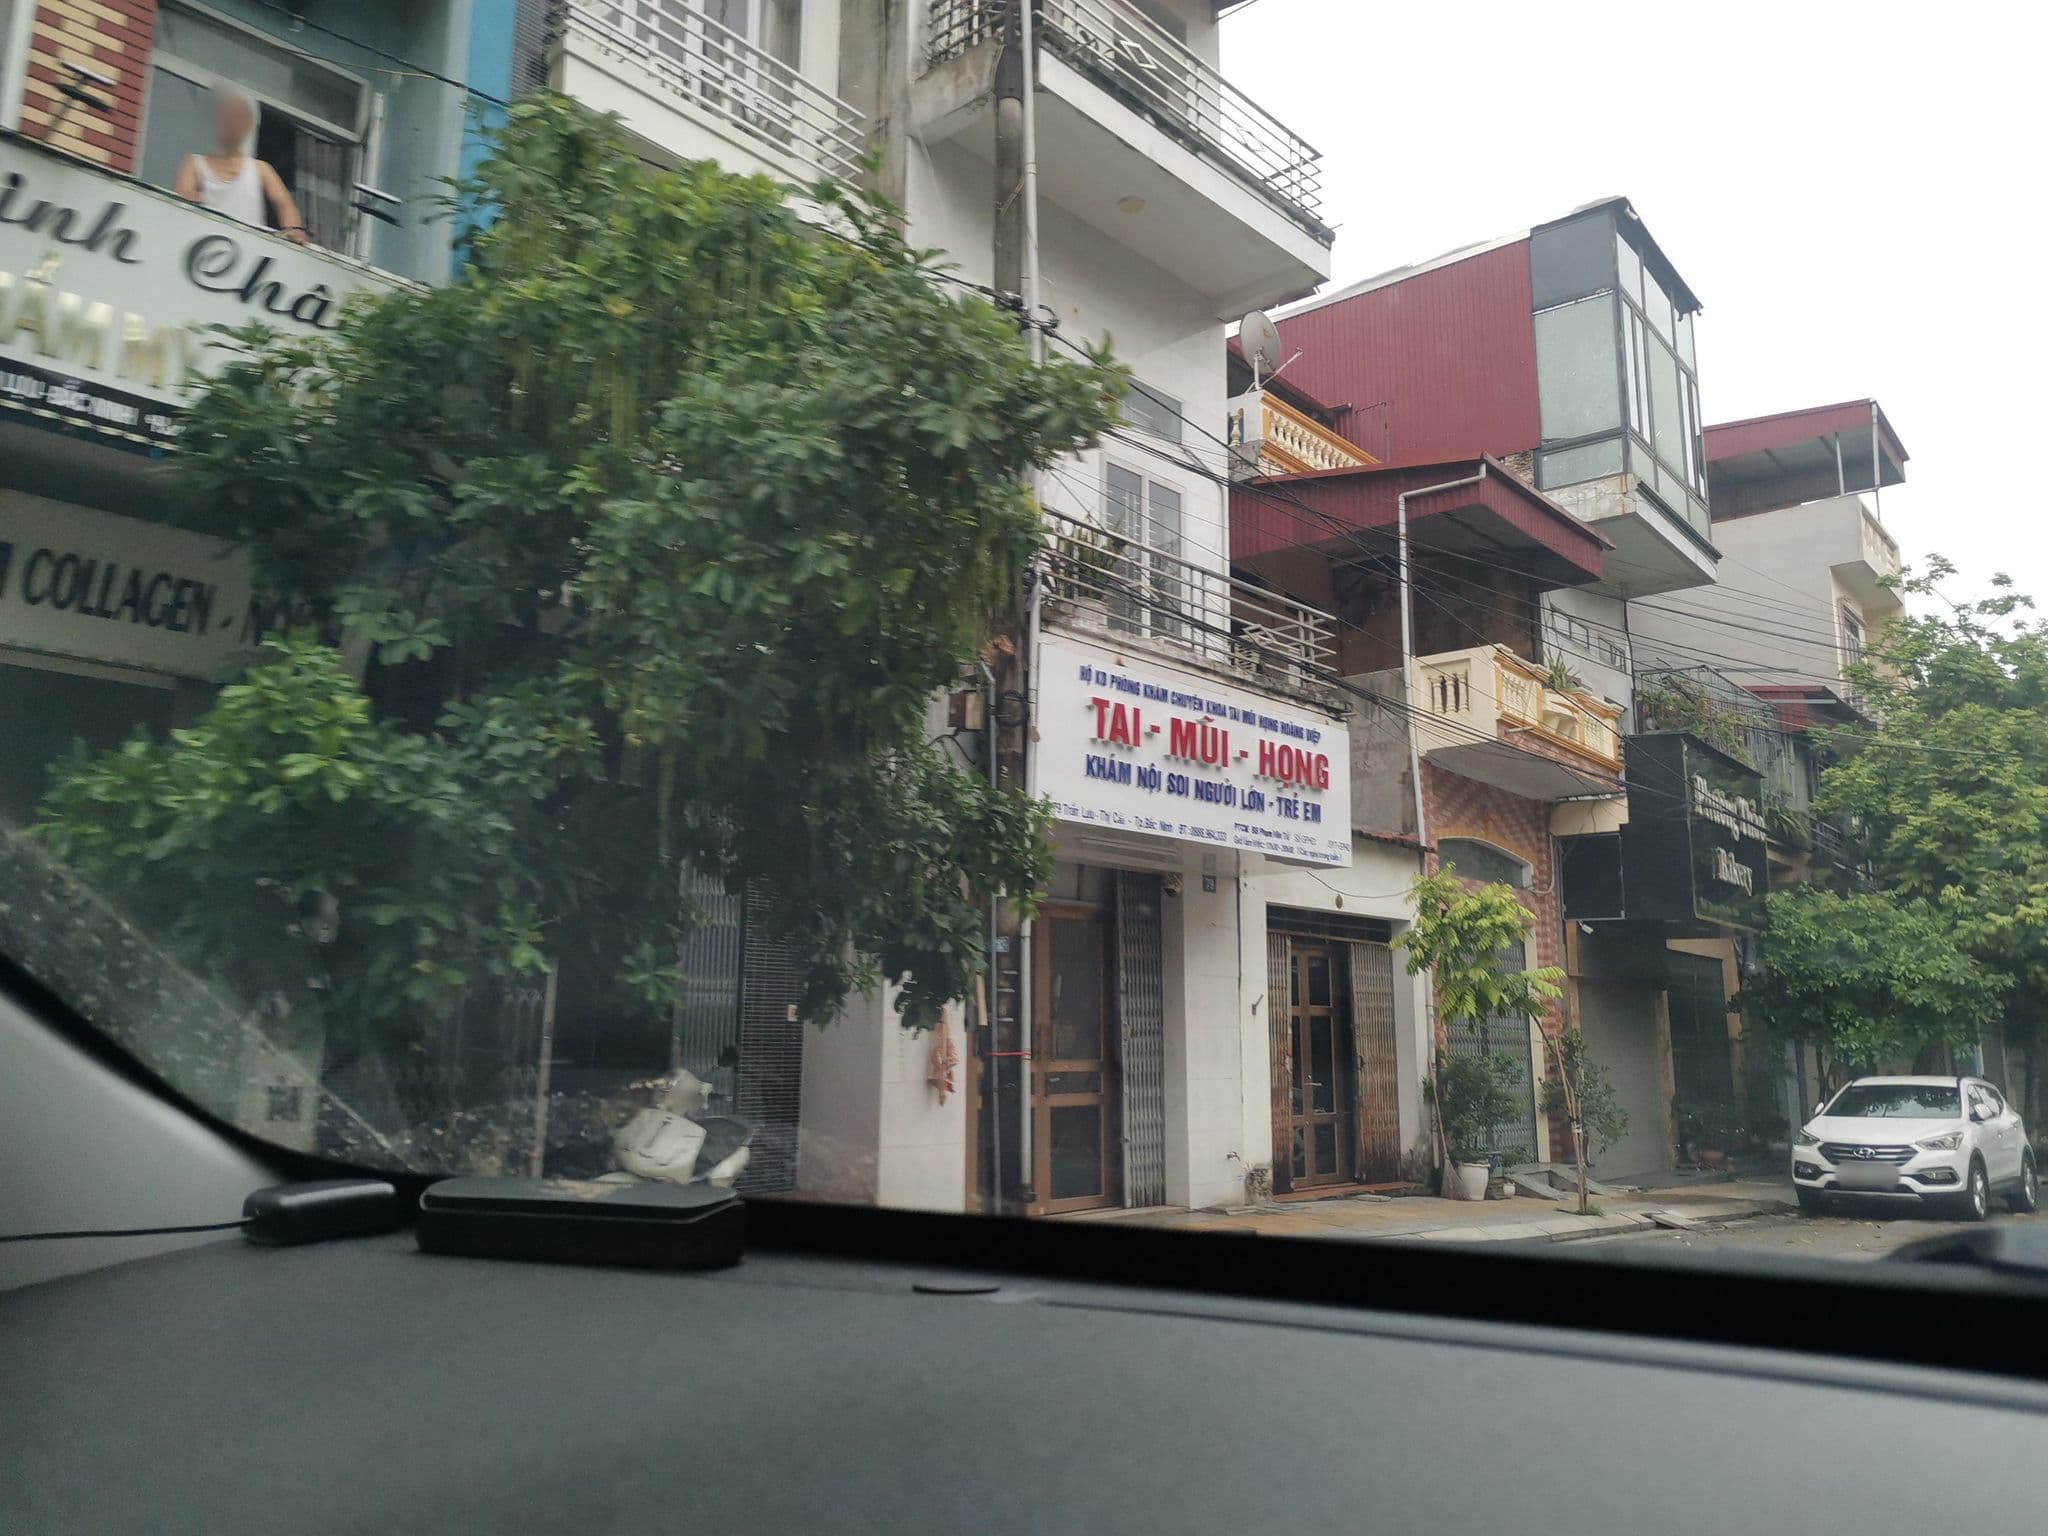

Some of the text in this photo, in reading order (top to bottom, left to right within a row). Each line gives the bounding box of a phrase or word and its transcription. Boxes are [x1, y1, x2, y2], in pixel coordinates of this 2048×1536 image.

[0, 172, 344, 331] inh Châ
[23, 547, 217, 635] COLLAGEN
[1092, 696, 1141, 747] TAI
[1169, 715, 1229, 768] MŨI
[1259, 738, 1330, 790] HỌNG
[1206, 700, 1227, 718] KHOA
[1085, 753, 1131, 786] KHÁM
[1136, 763, 1162, 798] NỘI
[1167, 774, 1190, 797] SOI
[1194, 778, 1237, 808] NGƯỜI
[1240, 784, 1265, 812] LỚN
[1276, 792, 1299, 819] TRẺ
[1304, 801, 1322, 823] EM
